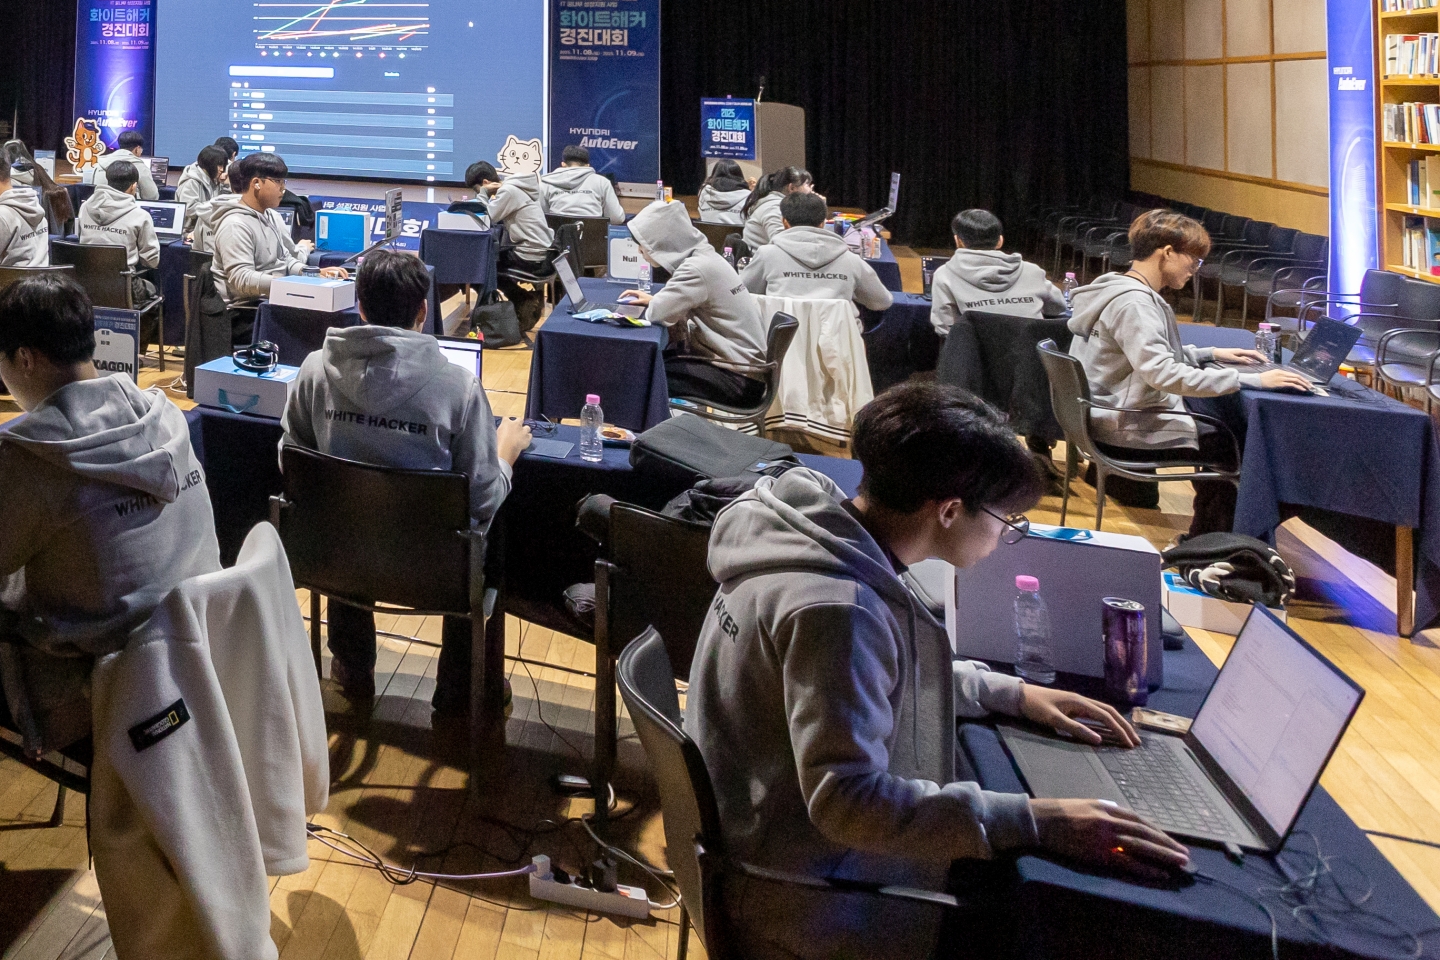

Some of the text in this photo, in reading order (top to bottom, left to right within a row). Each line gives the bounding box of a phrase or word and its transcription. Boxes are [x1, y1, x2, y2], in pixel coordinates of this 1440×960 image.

[89, 8, 150, 21] 화이트해커
[560, 10, 647, 28] 화이트해커
[102, 23, 149, 37] 경진대회
[560, 28, 628, 46] 경진대회
[707, 118, 749, 131] 화이트해커
[569, 127, 610, 136] HYUNDAI
[712, 130, 746, 144] 경진대회
[579, 136, 638, 150] AutoEver
[101, 226, 128, 236] HACKER
[622, 255, 638, 263] Null
[783, 271, 848, 281] WHITE HACKER
[965, 296, 1035, 308] WHITE HACKER
[324, 409, 428, 436] WHITE HACKER
